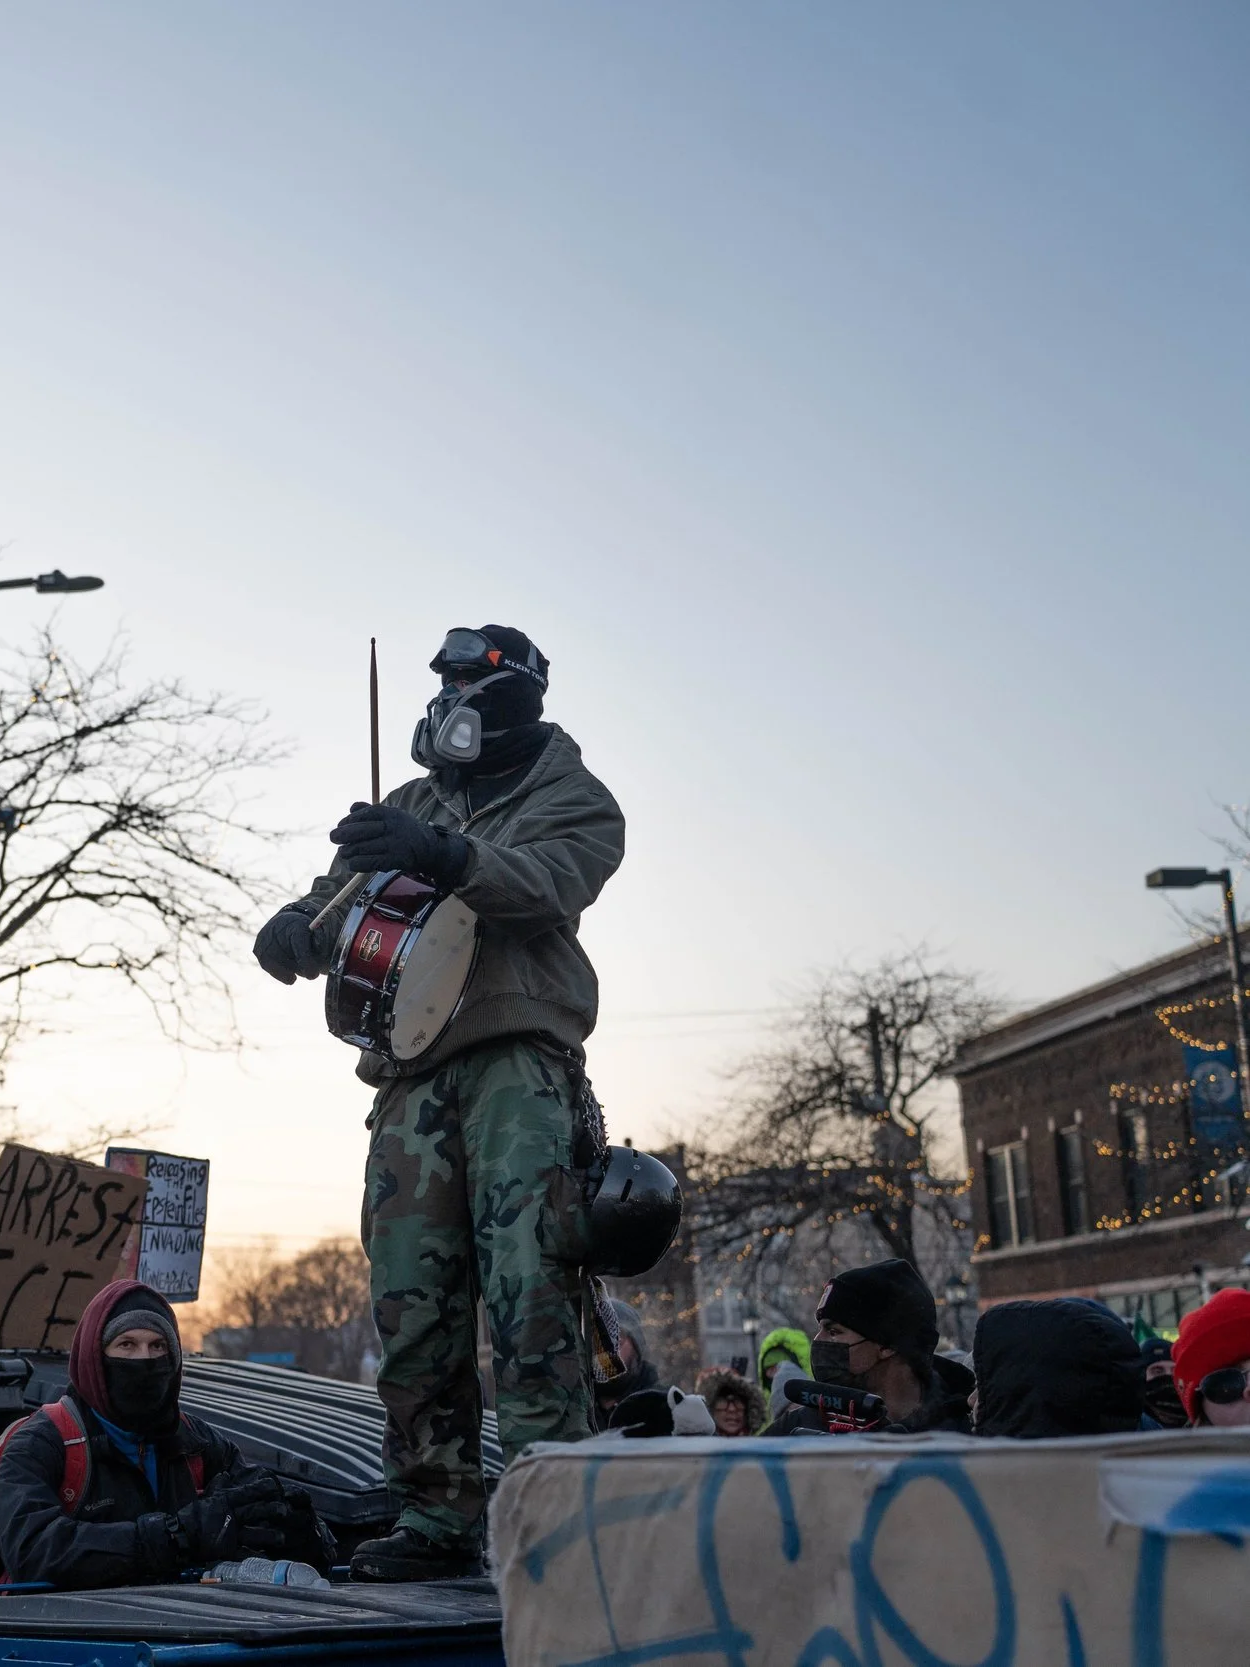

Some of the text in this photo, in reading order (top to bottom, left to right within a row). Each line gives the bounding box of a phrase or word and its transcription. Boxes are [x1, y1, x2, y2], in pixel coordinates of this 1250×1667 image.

[505, 659, 530, 674] KLEIN
[165, 1178, 185, 1190] THE
[142, 1227, 204, 1254] INVADING
